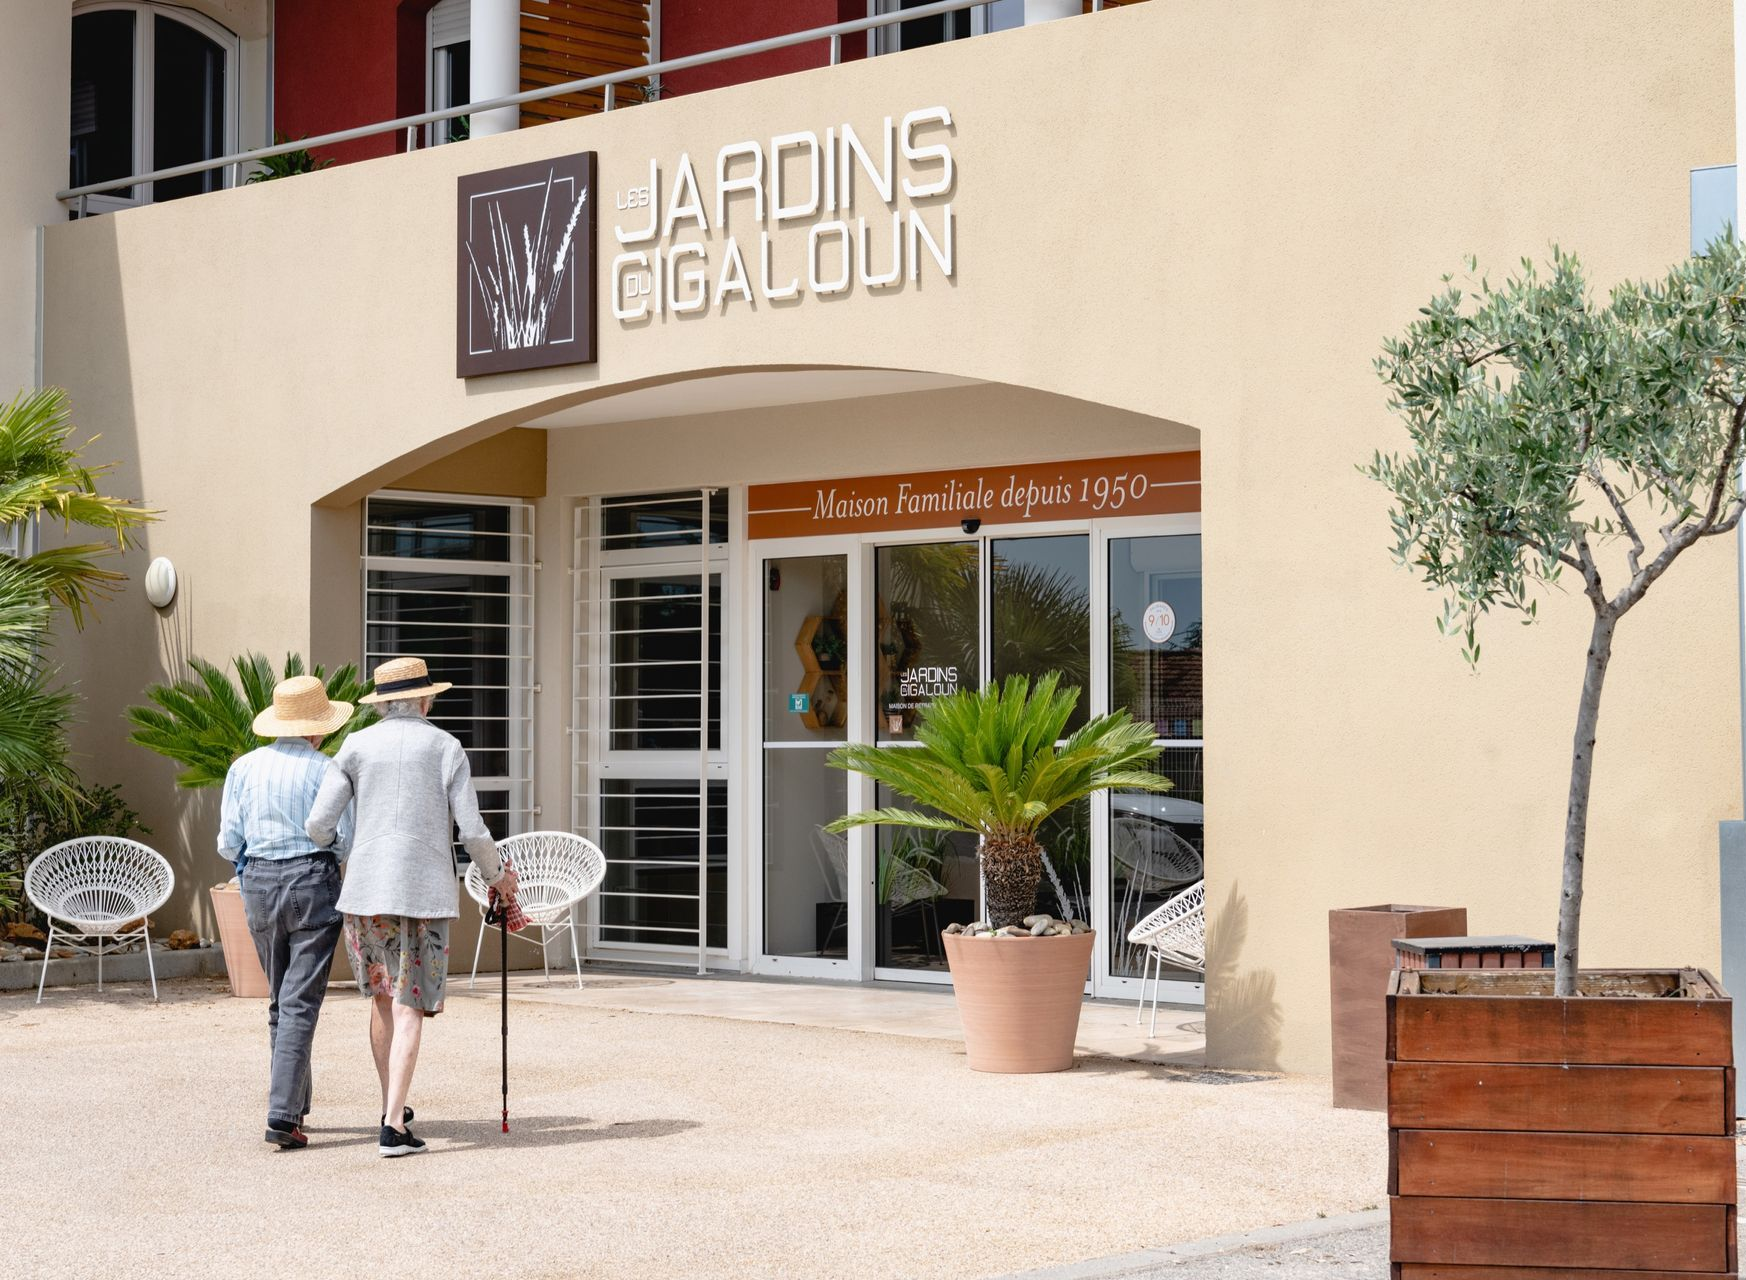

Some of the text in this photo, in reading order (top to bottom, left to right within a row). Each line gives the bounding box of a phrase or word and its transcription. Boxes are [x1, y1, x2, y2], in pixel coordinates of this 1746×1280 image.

[614, 105, 953, 243] LES JARDINS
[611, 203, 953, 320] DU CIGALOUN
[812, 472, 1148, 520] Maison Familiale depuis 1950
[900, 666, 958, 683] JARDINS
[900, 683, 958, 697] CIGALOUN
